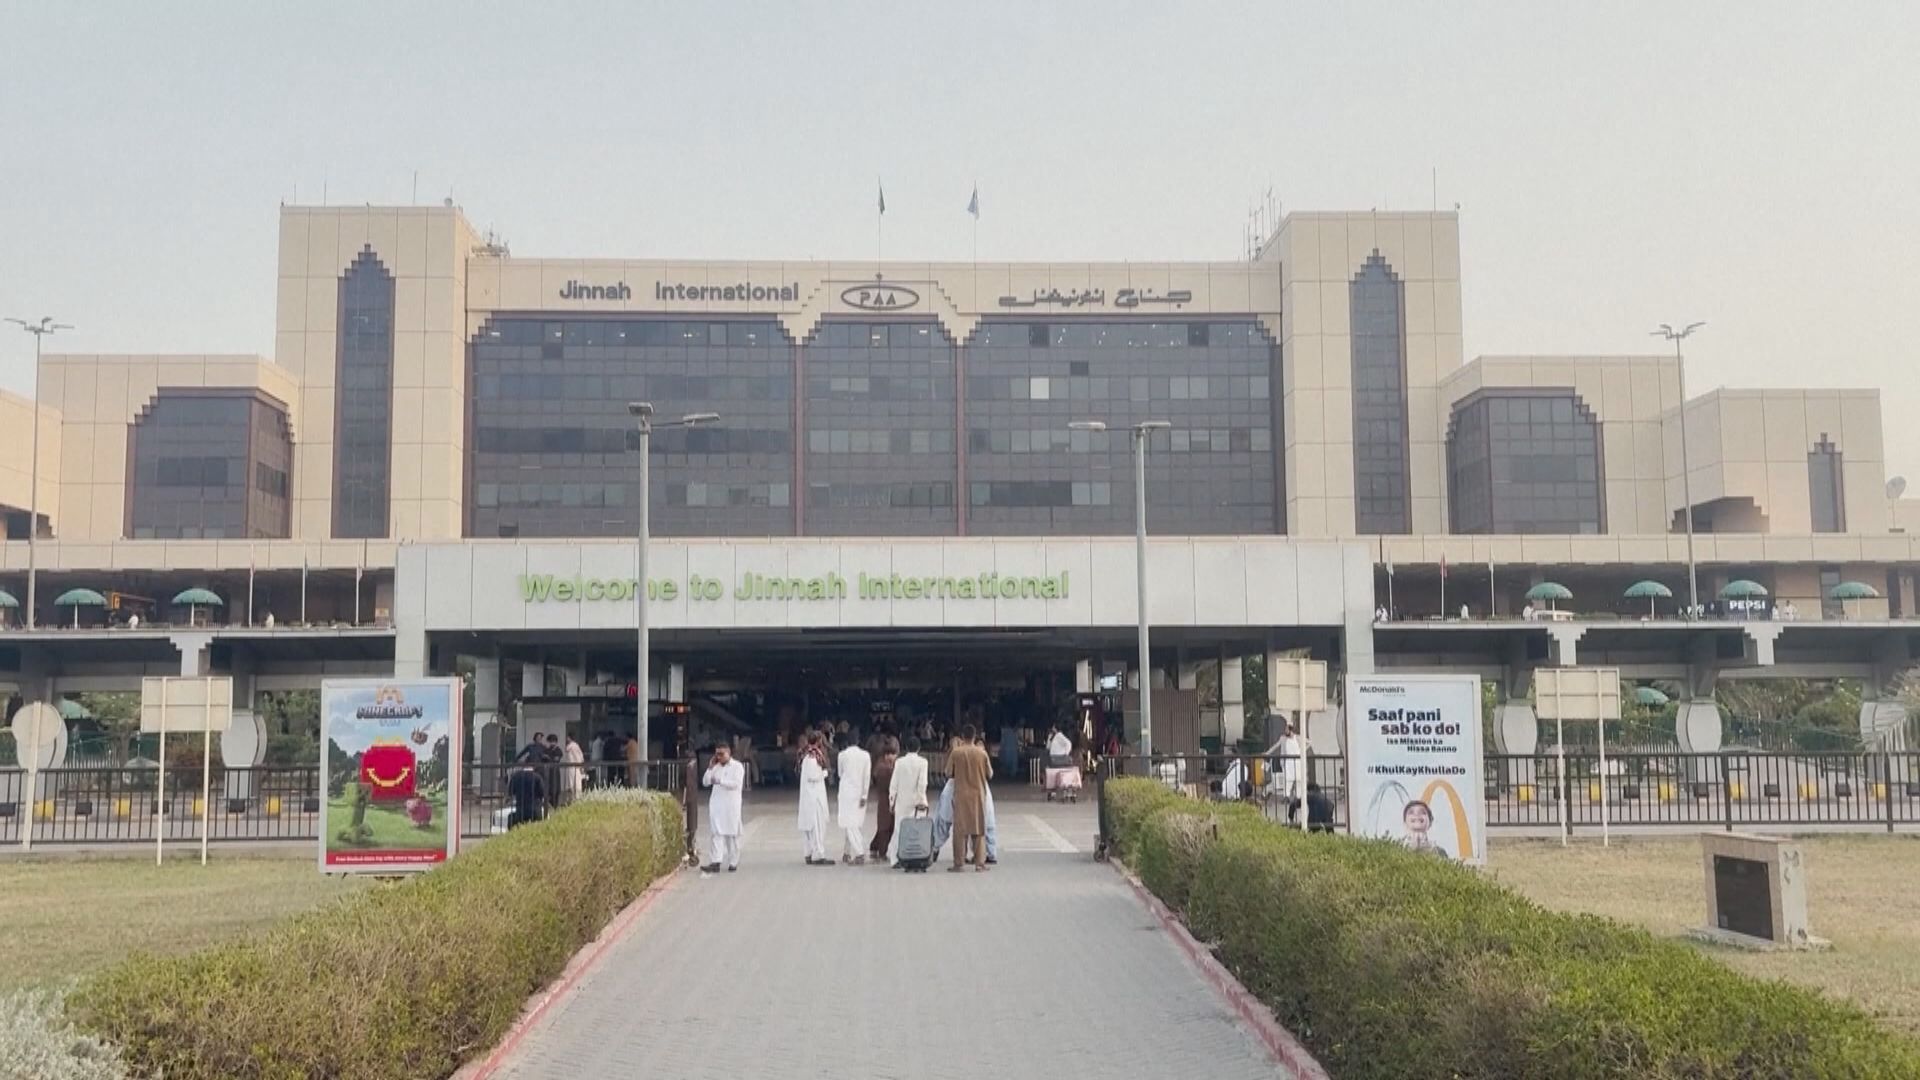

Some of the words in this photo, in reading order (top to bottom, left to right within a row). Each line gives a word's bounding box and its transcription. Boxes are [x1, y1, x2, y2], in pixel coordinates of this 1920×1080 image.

[559, 280, 631, 300] Jinnah
[655, 281, 799, 301] International
[860, 291, 897, 307] PAA
[519, 573, 679, 602] Welcome
[690, 573, 723, 600] to
[734, 571, 848, 600] Jinnah
[859, 571, 1070, 600] International
[1729, 600, 1766, 610] PEPSI
[1368, 708, 1403, 721] Saaf
[1406, 708, 1441, 723] pani
[1381, 722, 1410, 735] sab
[1412, 722, 1432, 735] ko
[1434, 722, 1460, 735] do!
